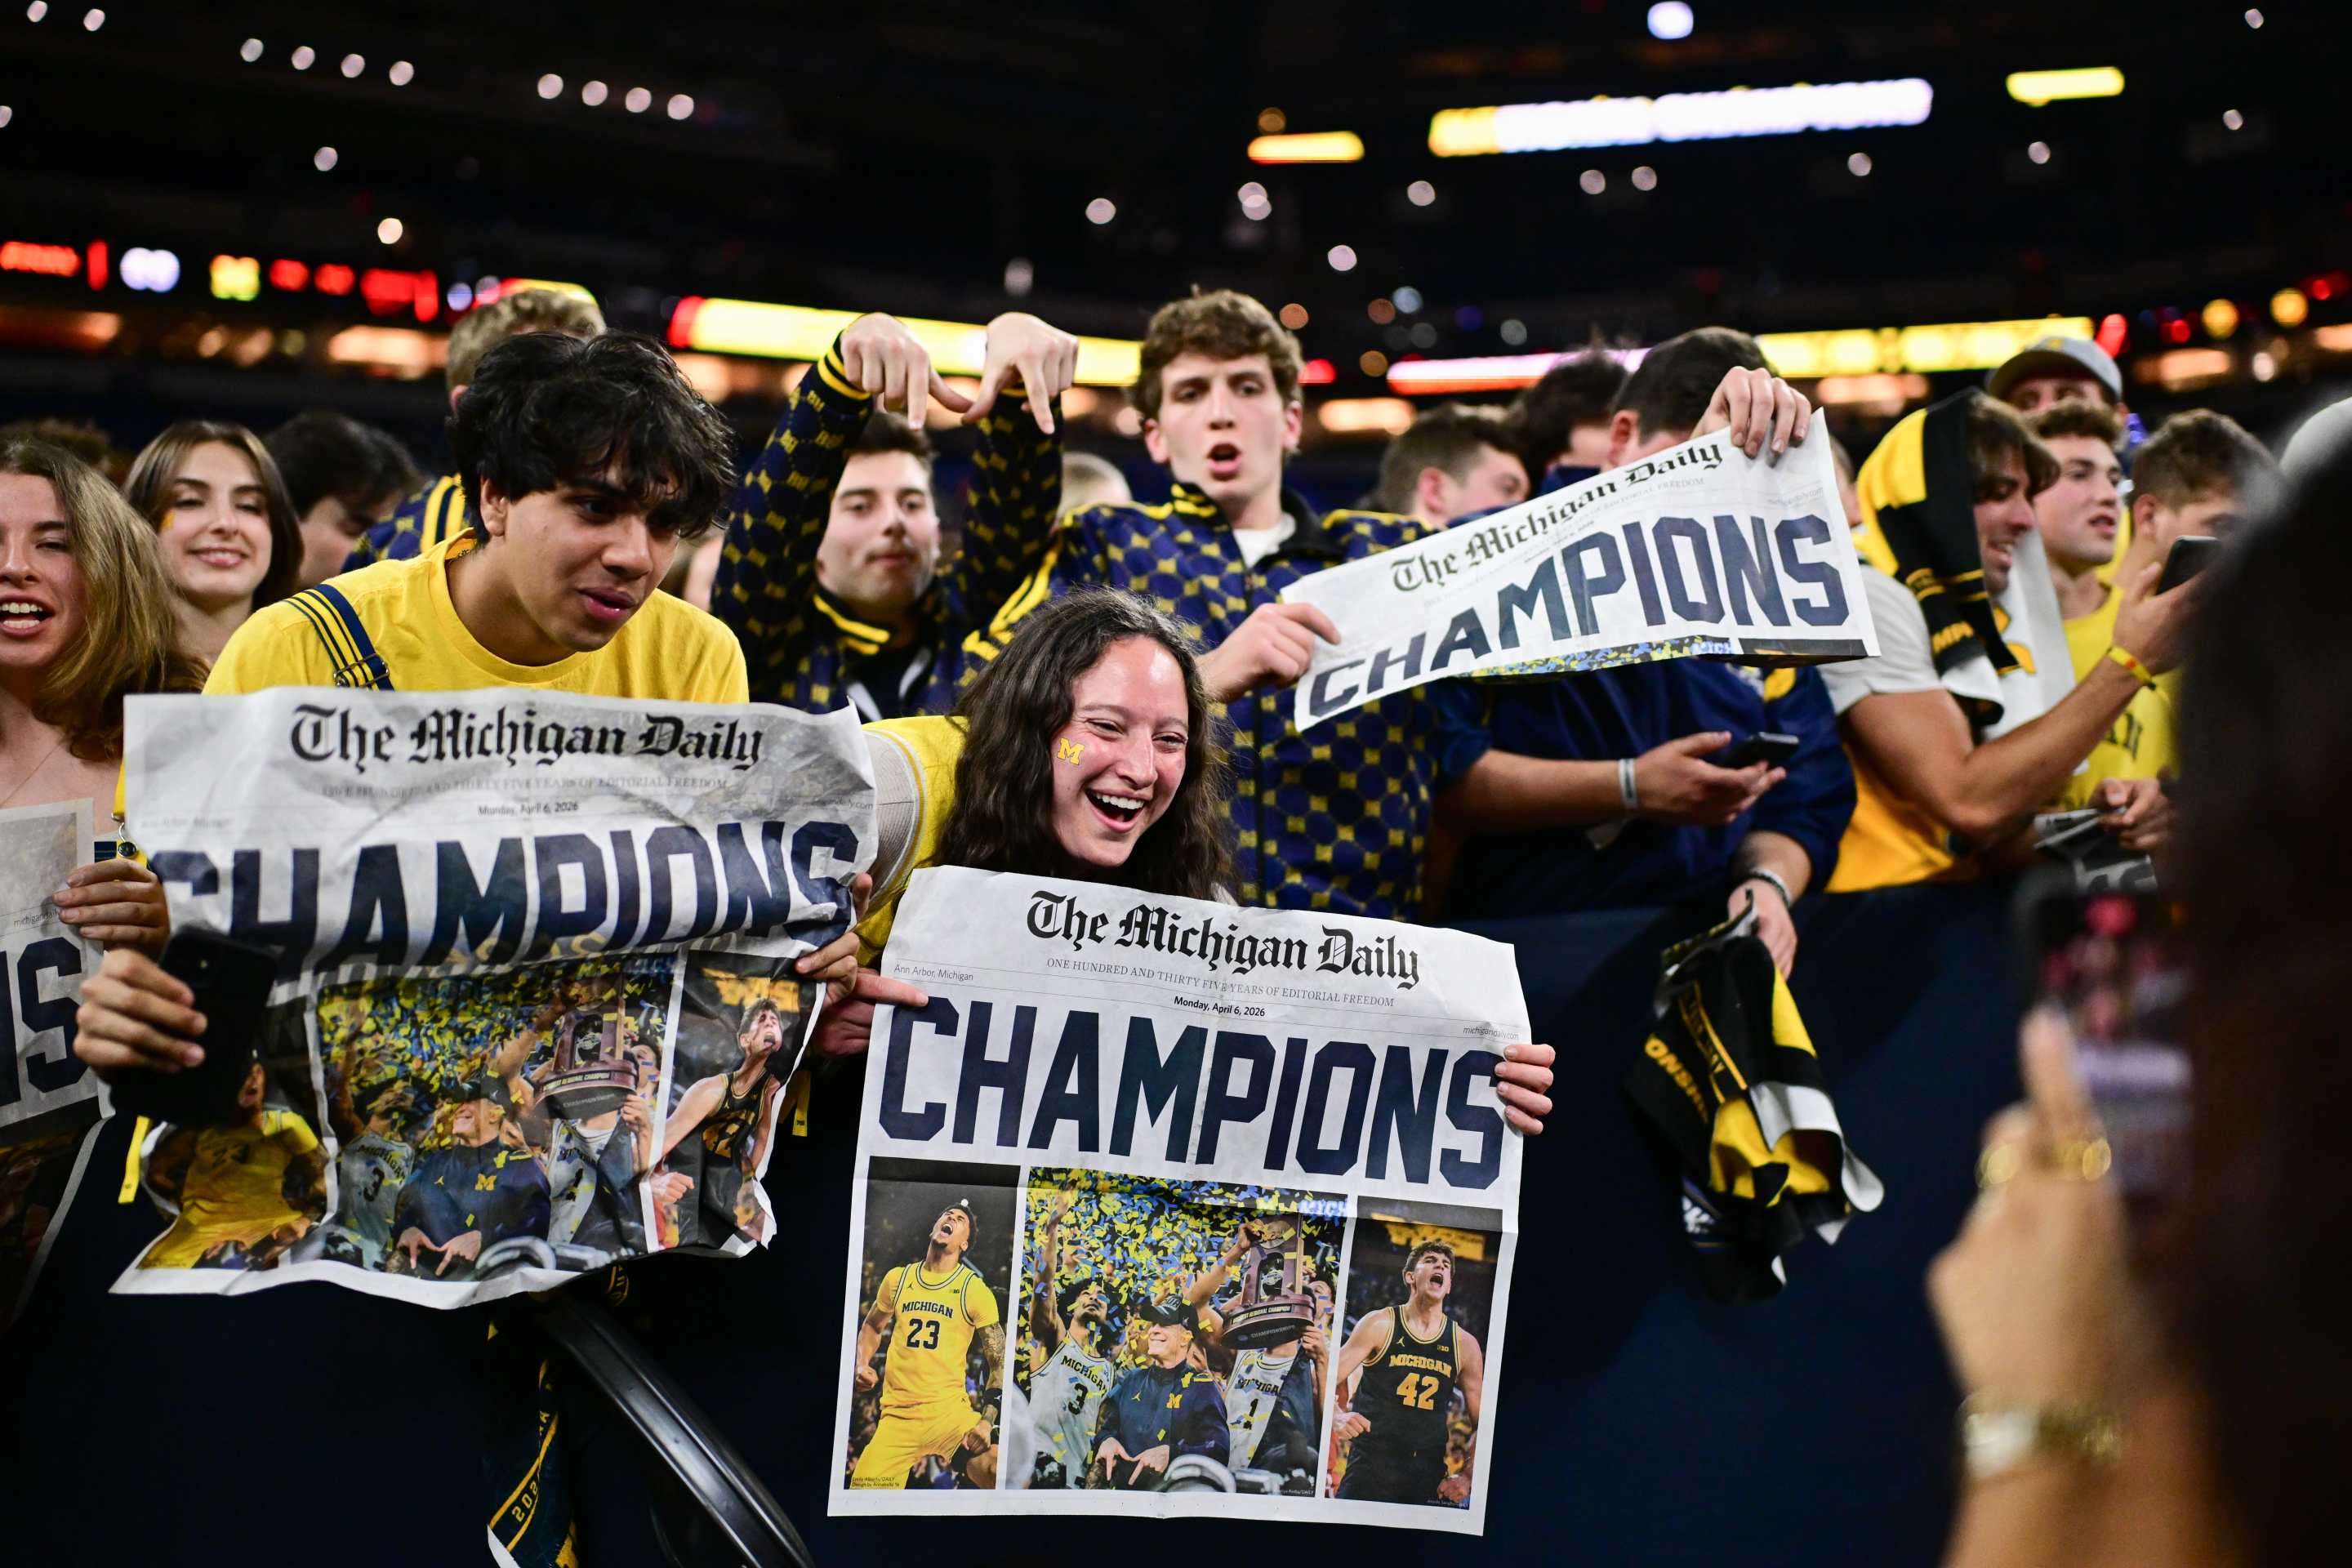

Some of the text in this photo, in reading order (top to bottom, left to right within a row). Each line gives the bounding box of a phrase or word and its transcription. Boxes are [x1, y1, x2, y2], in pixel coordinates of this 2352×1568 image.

[1391, 552, 1459, 591] The
[1466, 482, 1617, 567] Michigan
[1625, 444, 1723, 488] Daily
[1309, 514, 1849, 718] CHAMPIONS
[291, 703, 764, 774] The Michigan Daily
[1057, 737, 1085, 765] M
[666, 777, 727, 790] FREEDOM
[555, 801, 579, 813] 2026
[1027, 889, 1420, 990] The Michigan Daily
[895, 964, 973, 982] Ann Arbor, Michigan
[1047, 957, 1395, 1008] ONE HUNDRED AND THIRTY FIVE YEARS OF EDITORIAL FREEDOM
[1174, 996, 1266, 1018] Monday, April 6, 2026
[1463, 1024, 1520, 1041] michigandaily.com
[879, 996, 1503, 1190] CHAMPIONS
[363, 1167, 385, 1205] 3
[902, 1301, 954, 1319] MICHIGAN
[906, 1318, 941, 1350] 23
[1389, 1354, 1452, 1379] MICHIGAN
[1067, 1383, 1089, 1415] 3
[1396, 1373, 1440, 1410] 42
